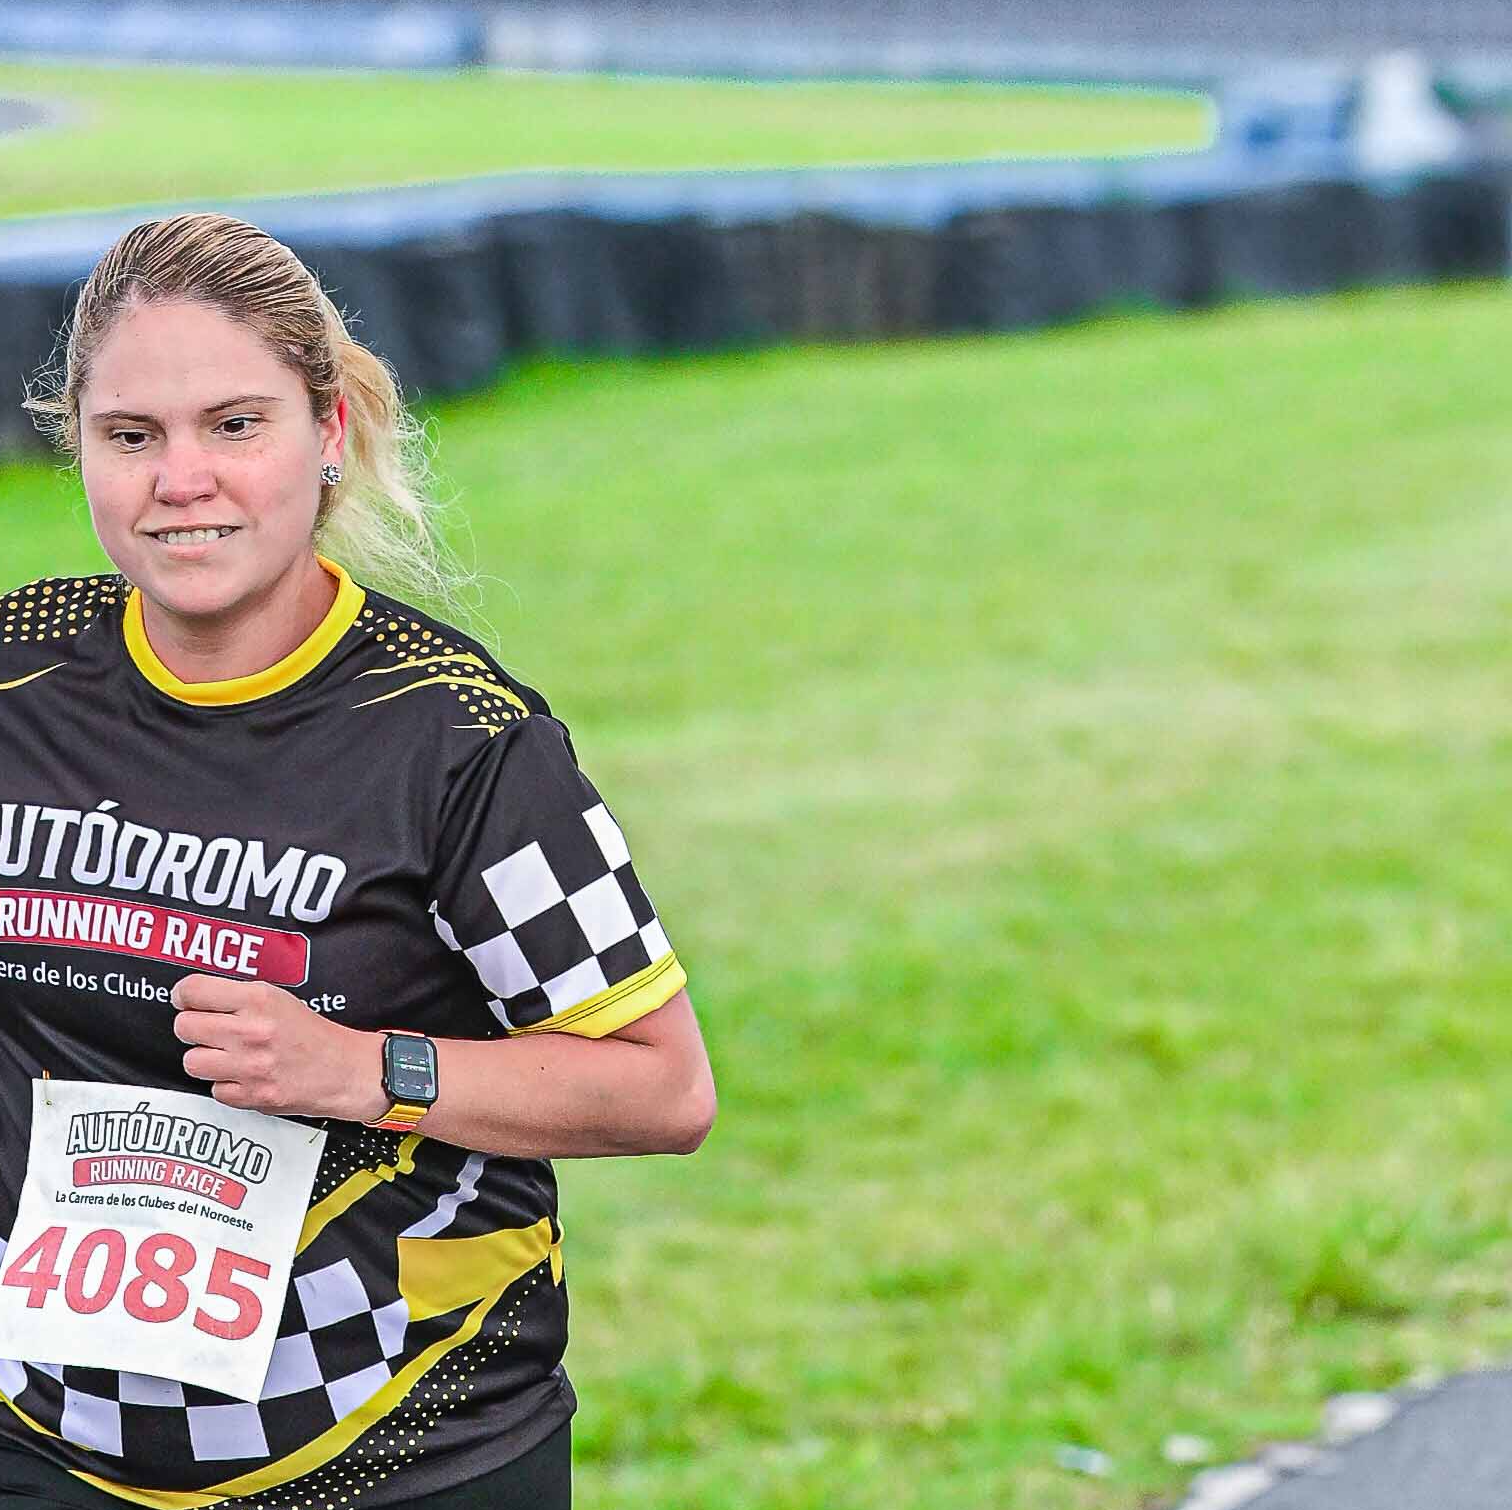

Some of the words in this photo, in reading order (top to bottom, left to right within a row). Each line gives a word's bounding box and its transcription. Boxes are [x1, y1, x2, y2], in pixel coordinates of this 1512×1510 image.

[161, 915, 265, 976] RACE
[32, 961, 60, 986] de
[66, 965, 98, 991] los
[103, 972, 172, 1003] Clube
[66, 1102, 272, 1184] AUTÓDROMO
[90, 1160, 166, 1183] RUNNING
[170, 1166, 226, 1200] RACE
[55, 1191, 66, 1203] La
[68, 1191, 104, 1205] Carrera
[106, 1193, 120, 1206] de
[121, 1193, 136, 1207] los
[138, 1195, 176, 1210] Clubes
[177, 1200, 199, 1215] del
[200, 1205, 254, 1232] Noroeste
[2, 1226, 271, 1341] 4085
